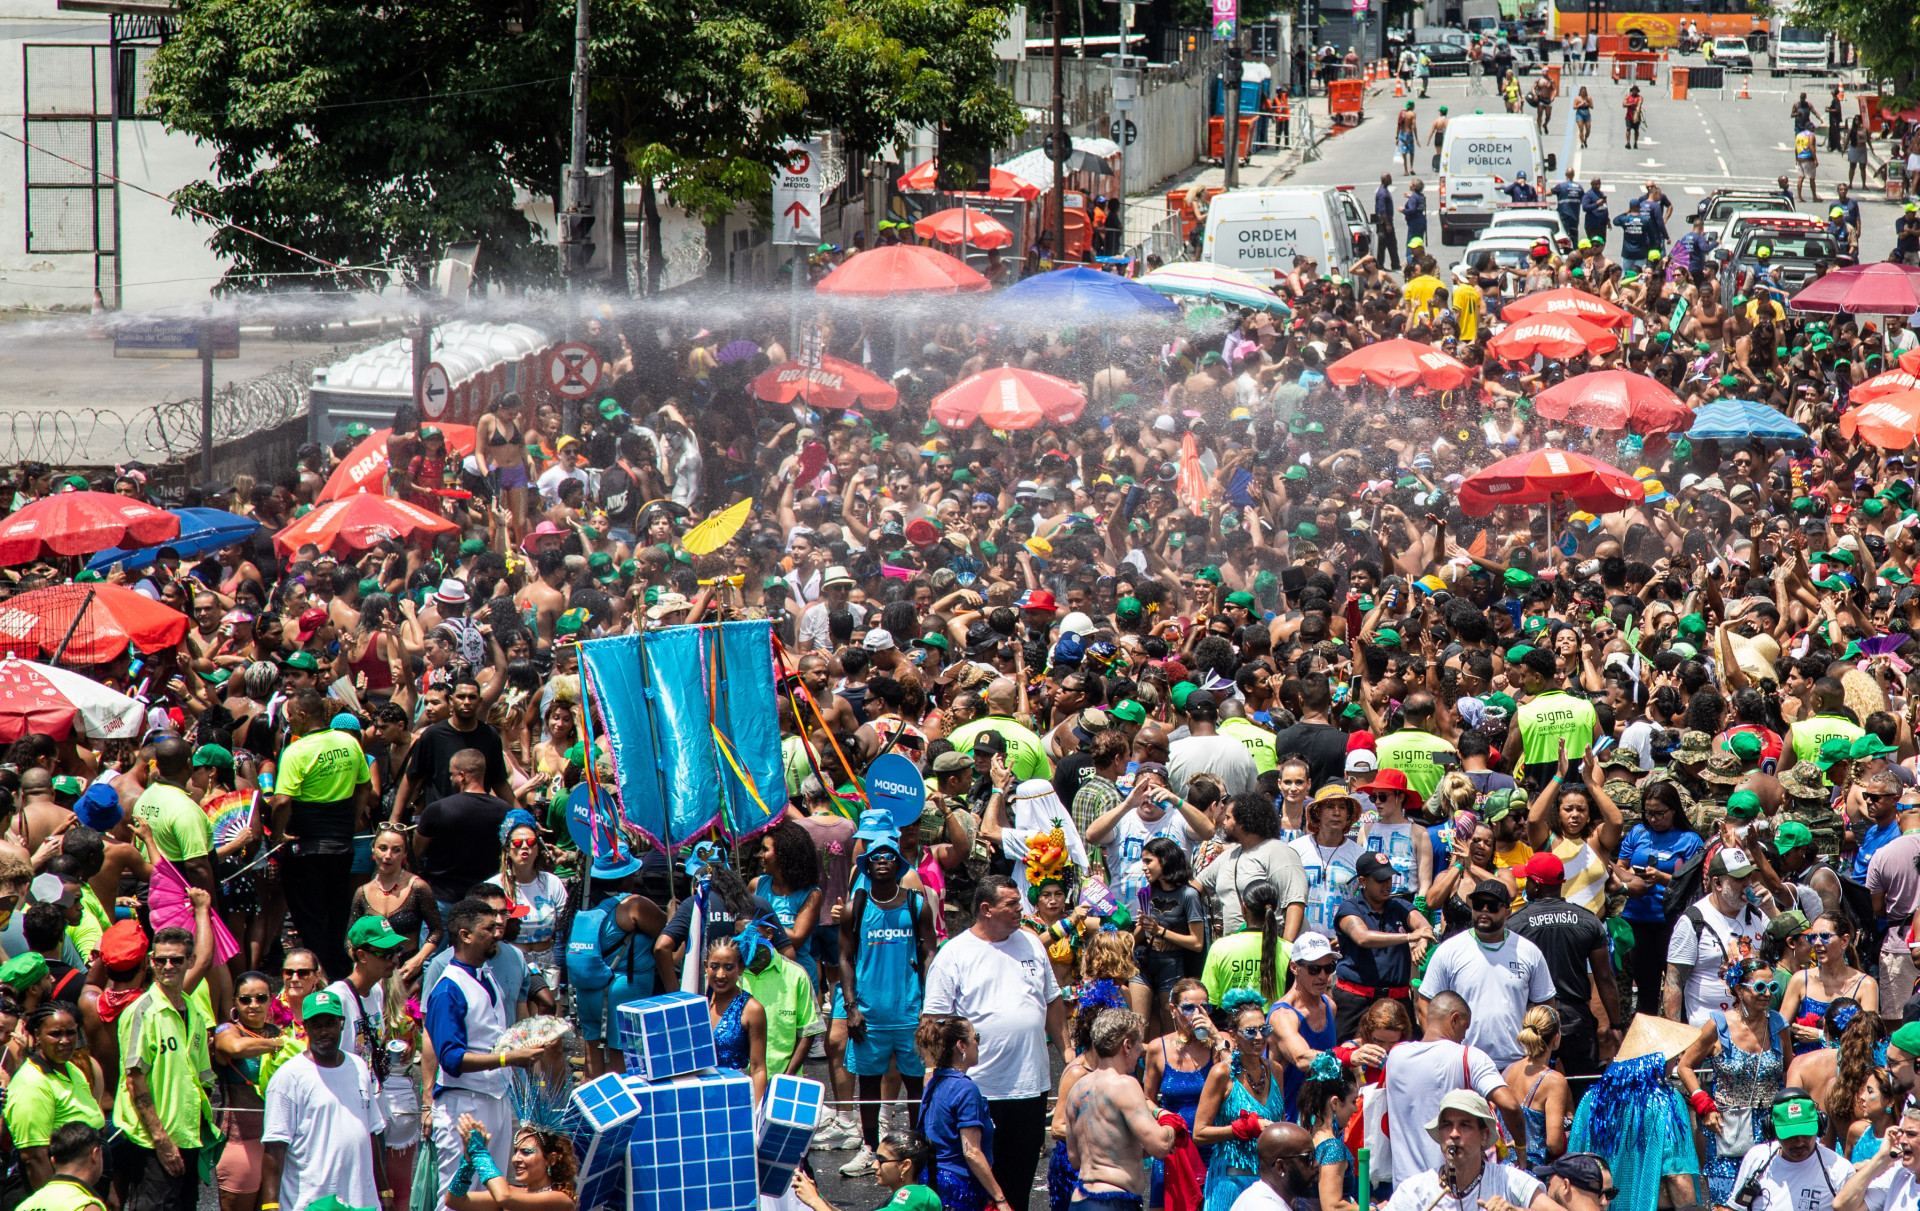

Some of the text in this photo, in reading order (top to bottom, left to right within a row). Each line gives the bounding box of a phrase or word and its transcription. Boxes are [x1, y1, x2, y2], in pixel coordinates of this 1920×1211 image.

[1468, 143, 1512, 153] ORDEM
[1468, 155, 1512, 165] PÚBLICA
[1238, 229, 1297, 243] ORDEM
[1239, 245, 1297, 259] PÚBLICA
[1547, 299, 1607, 315] BRAHMA
[156, 334, 183, 342] Castro
[1514, 324, 1572, 342] BRAHMA
[777, 368, 842, 390] BRAHMA
[607, 491, 628, 510] NIKE
[1536, 710, 1574, 725] sigma
[103, 716, 125, 736] TAIPAVA
[318, 747, 350, 765] sigma
[1393, 750, 1432, 763] sigma
[874, 778, 917, 796] Magalu
[141, 804, 160, 820] sigma
[1097, 898, 1113, 914] 180
[1528, 910, 1578, 927] SUPERVISÃO
[867, 928, 913, 941] Magalu
[778, 1009, 796, 1017] sigma
